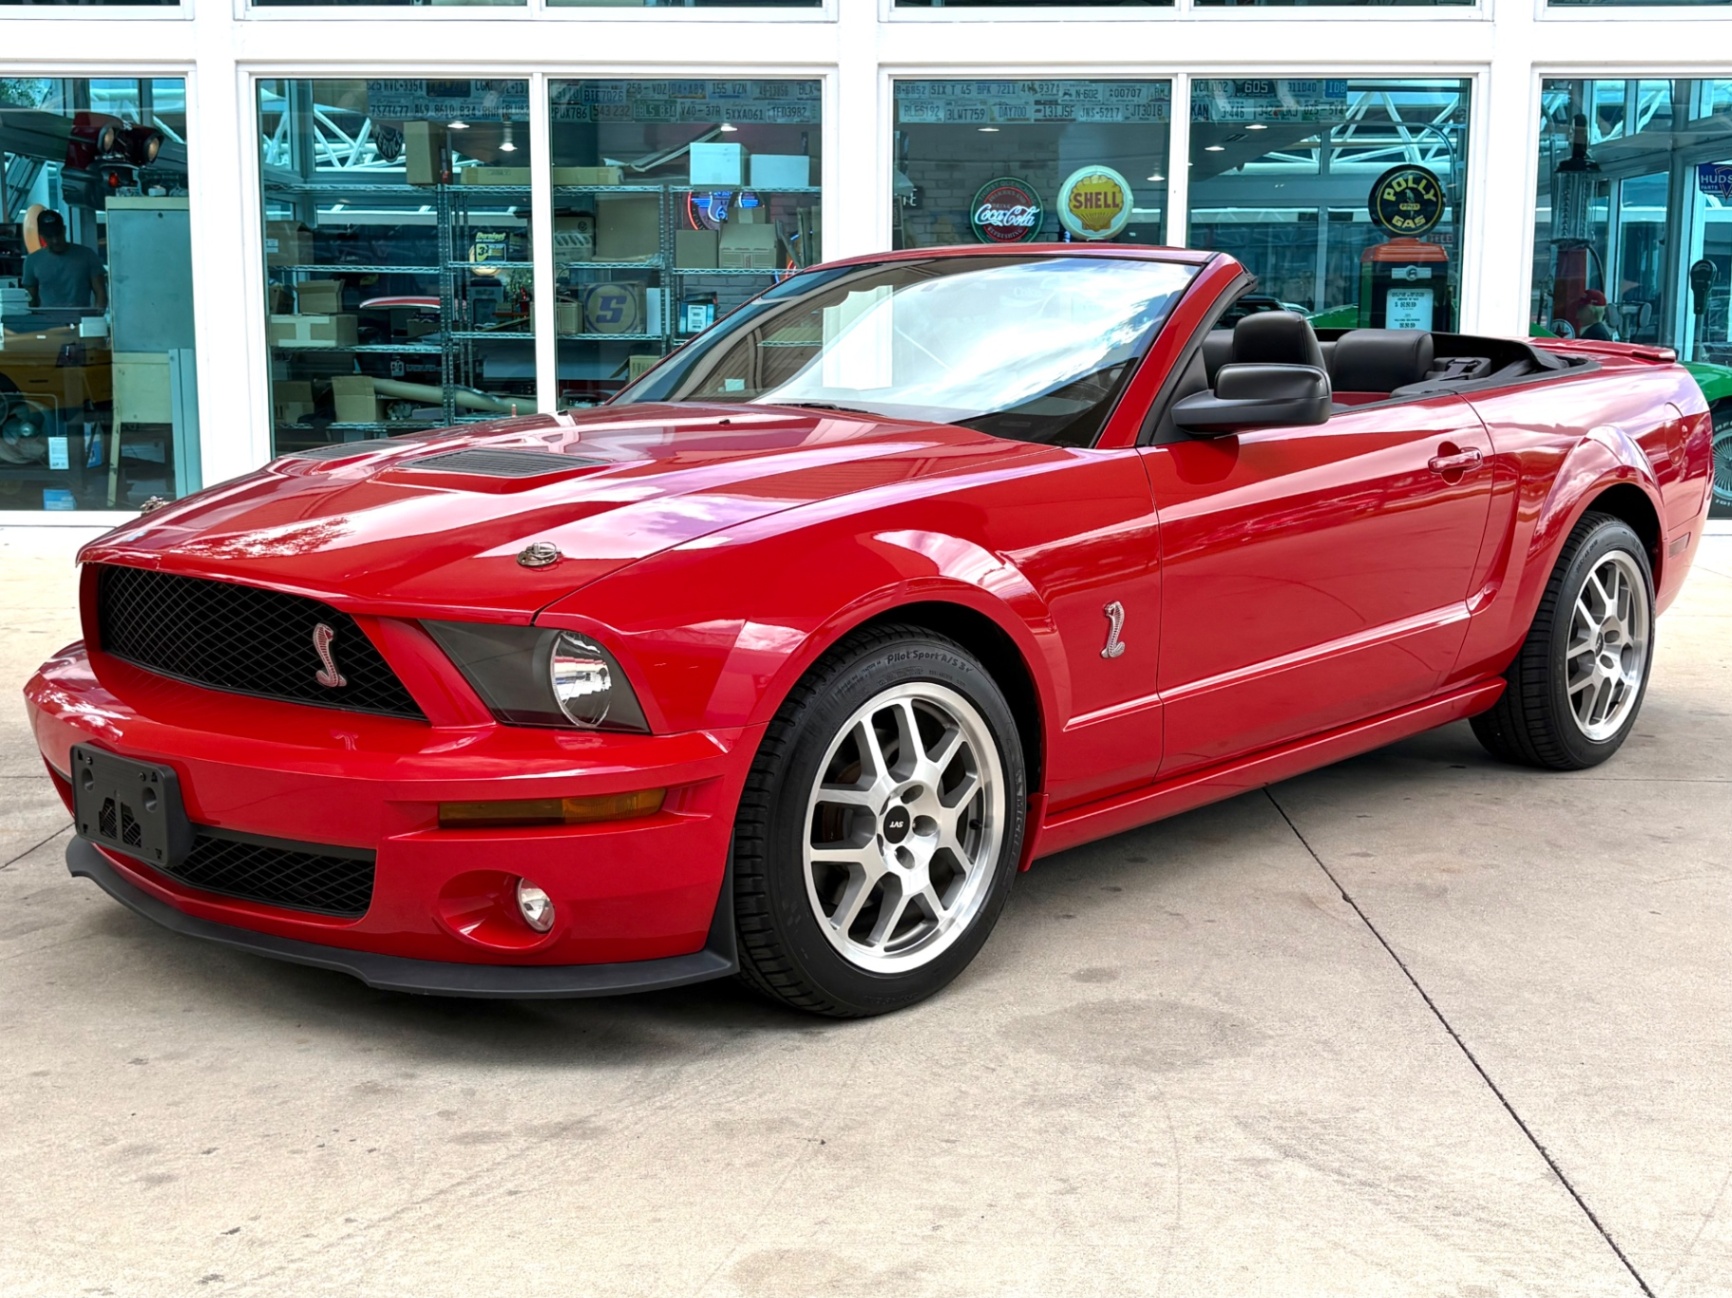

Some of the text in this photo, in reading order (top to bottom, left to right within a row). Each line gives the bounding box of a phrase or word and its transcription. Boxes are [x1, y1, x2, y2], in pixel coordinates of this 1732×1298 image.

[1383, 175, 1437, 202] POLLY
[1072, 191, 1120, 209] SHELL
[1391, 214, 1427, 229] GAS
[887, 651, 911, 664] Pilot
[913, 650, 940, 660] Sport
